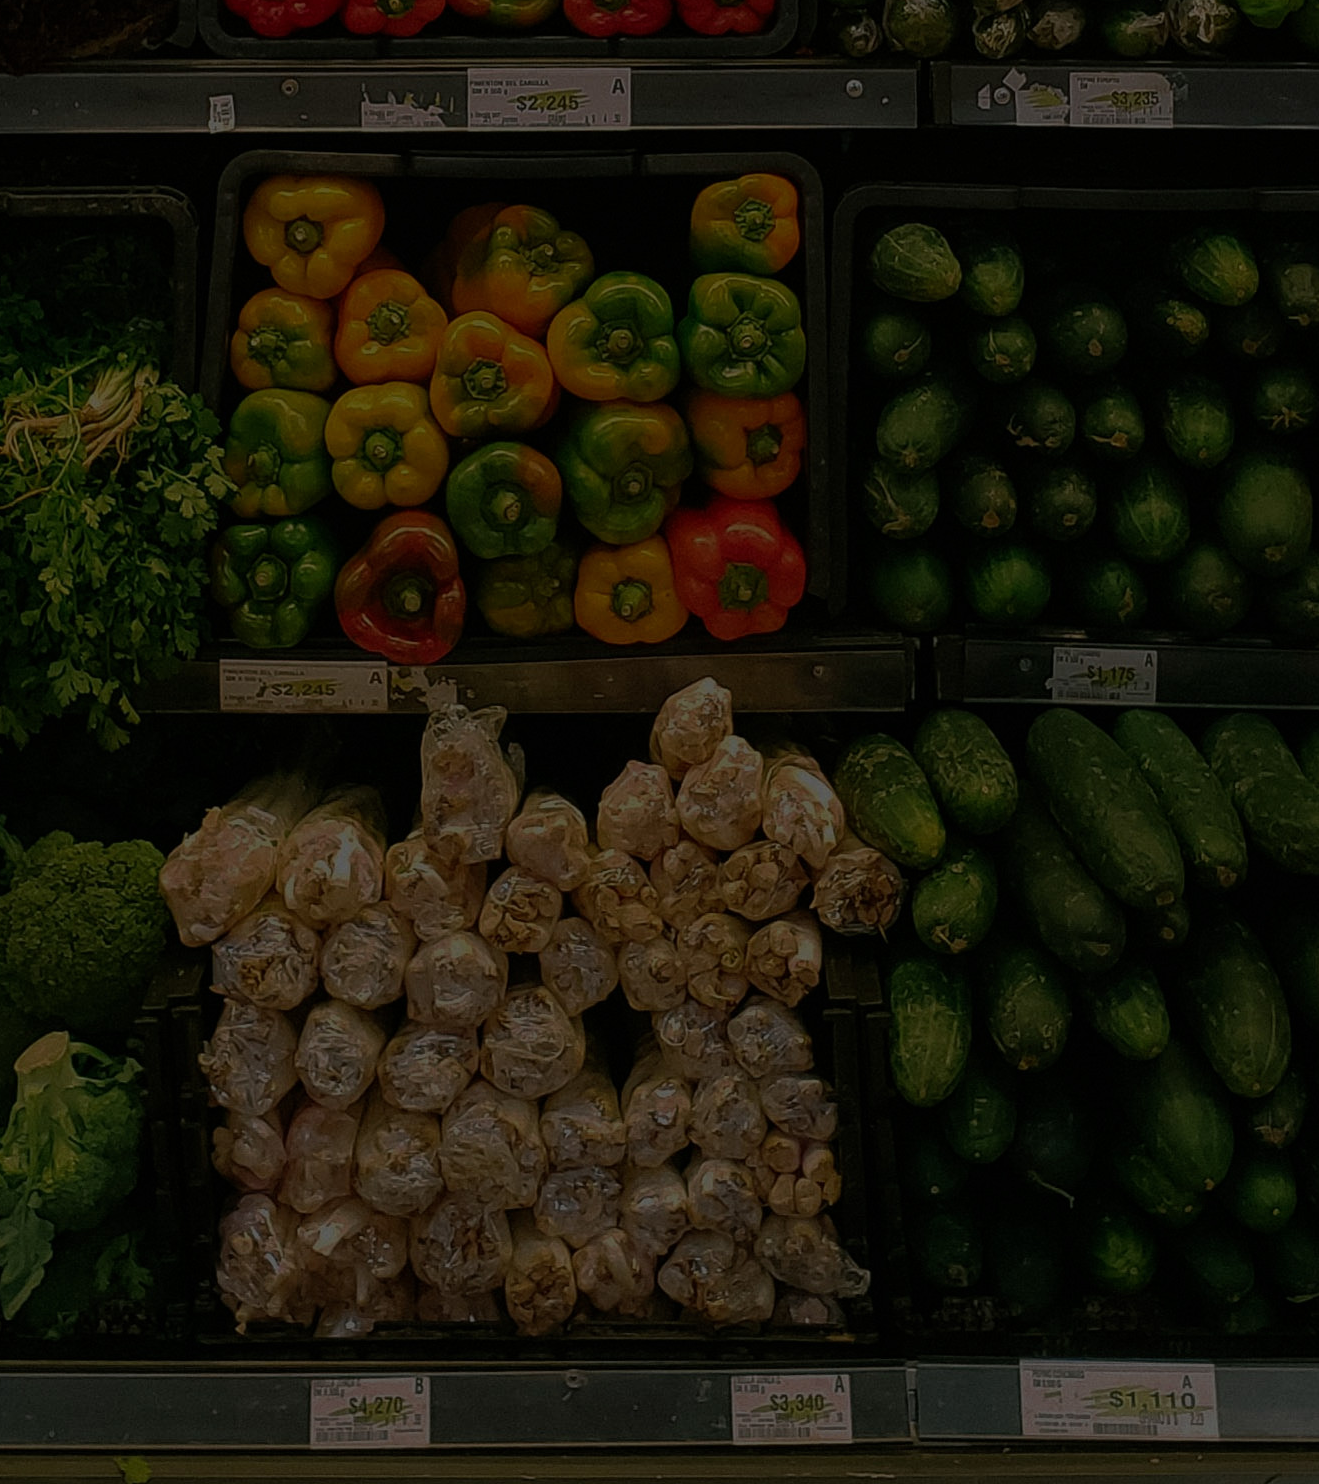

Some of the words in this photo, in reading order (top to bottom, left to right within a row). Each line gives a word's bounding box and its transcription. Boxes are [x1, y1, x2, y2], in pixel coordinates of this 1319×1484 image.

[612, 78, 625, 94] A
[517, 95, 579, 112] $2,245
[1112, 91, 1159, 108] $3,235
[1145, 653, 1153, 667] A
[369, 671, 382, 684] A
[1087, 665, 1136, 685] $1,175
[271, 683, 336, 698] $2,245
[415, 1377, 423, 1394] B
[835, 1375, 844, 1393] A
[1182, 1375, 1193, 1388] A
[349, 1397, 403, 1415] $4,270
[769, 1394, 824, 1413] $3,340
[1109, 1390, 1196, 1411] $1,110
